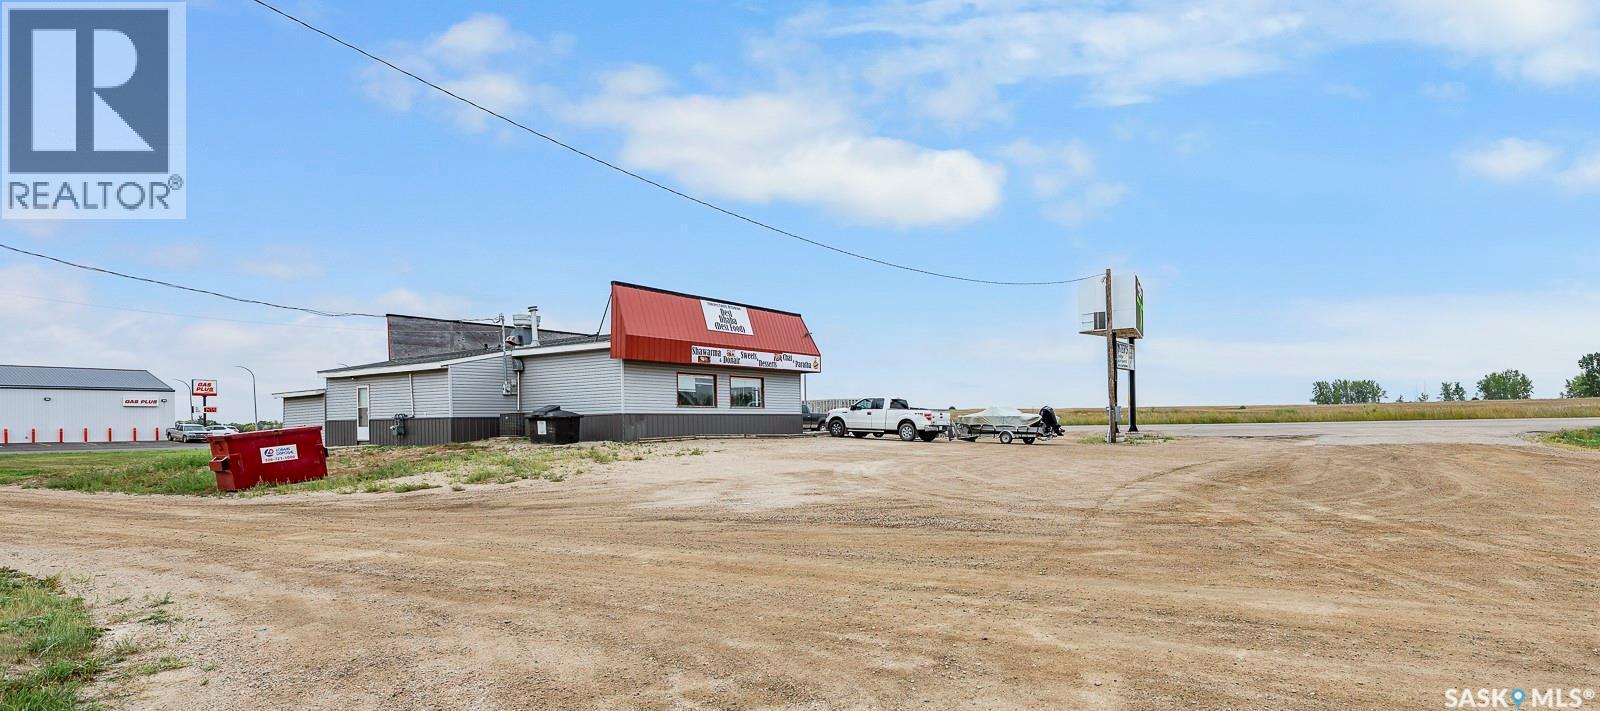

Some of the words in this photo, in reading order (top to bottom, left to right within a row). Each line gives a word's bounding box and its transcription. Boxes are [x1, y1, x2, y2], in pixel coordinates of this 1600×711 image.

[730, 323, 746, 333] Food)
[692, 347, 722, 357] Shawarma
[723, 356, 740, 364] Donair
[758, 360, 777, 368] Desserts
